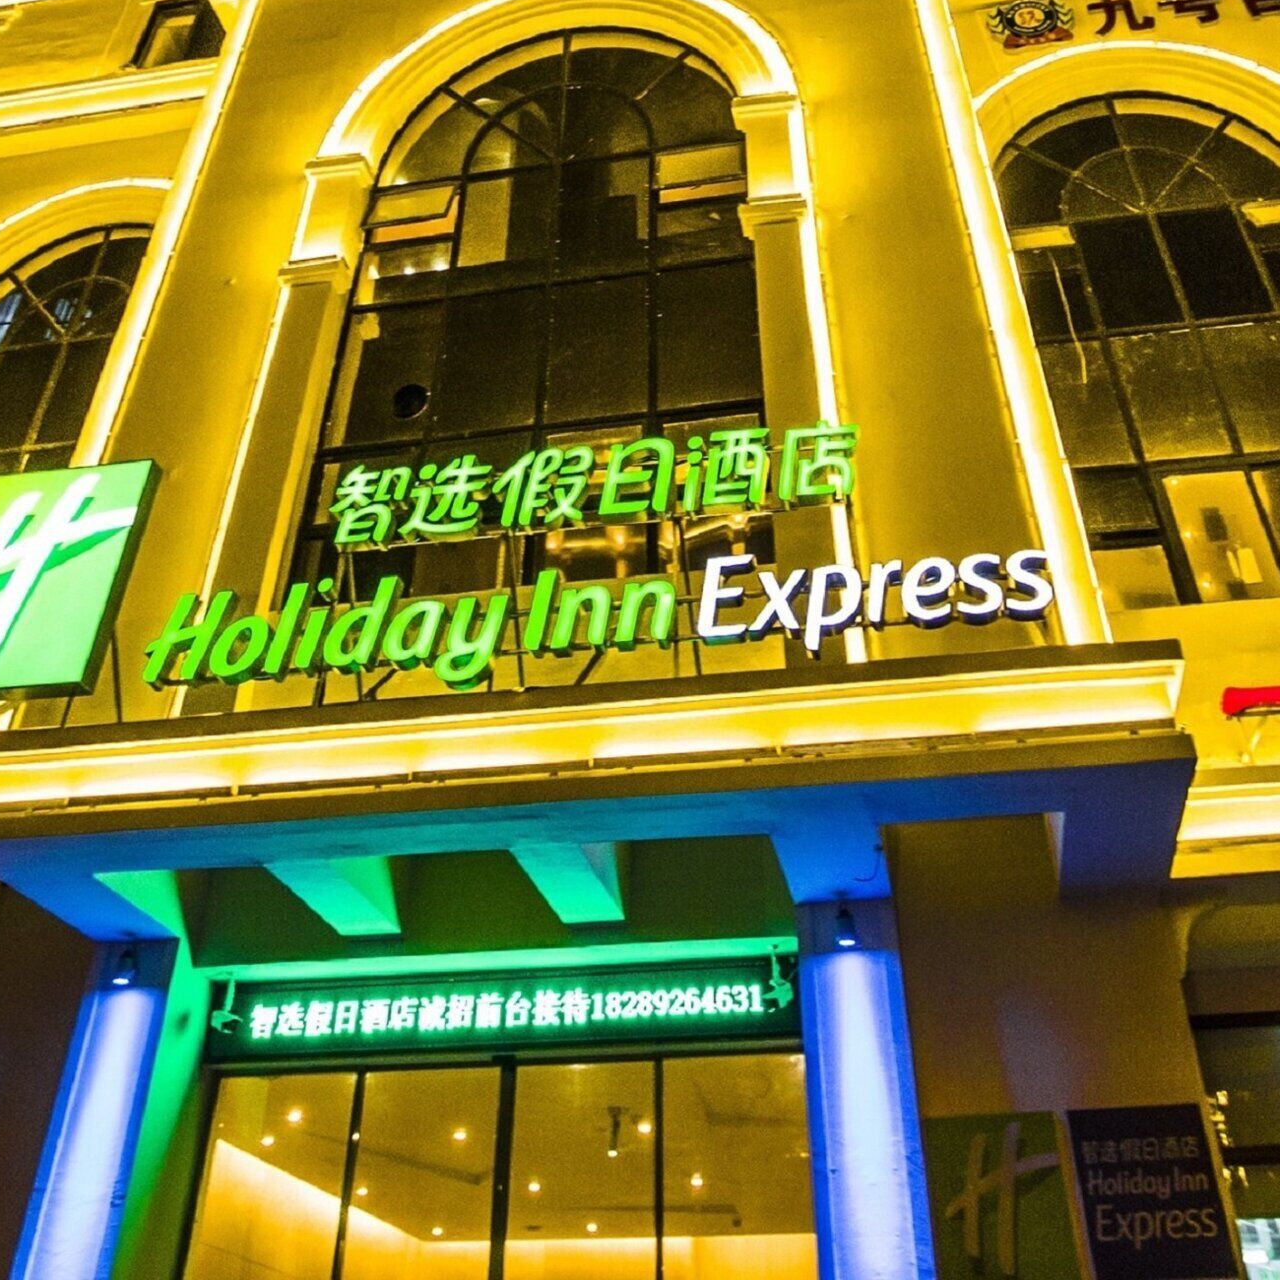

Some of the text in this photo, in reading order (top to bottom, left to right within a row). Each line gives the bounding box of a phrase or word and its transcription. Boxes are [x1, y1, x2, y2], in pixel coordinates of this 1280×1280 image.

[327, 419, 860, 551] 智选假日酒店
[141, 548, 1055, 690] Holiday Inn Express
[1087, 1166, 1209, 1200] Holiday Inn
[1095, 1203, 1219, 1251] Express
